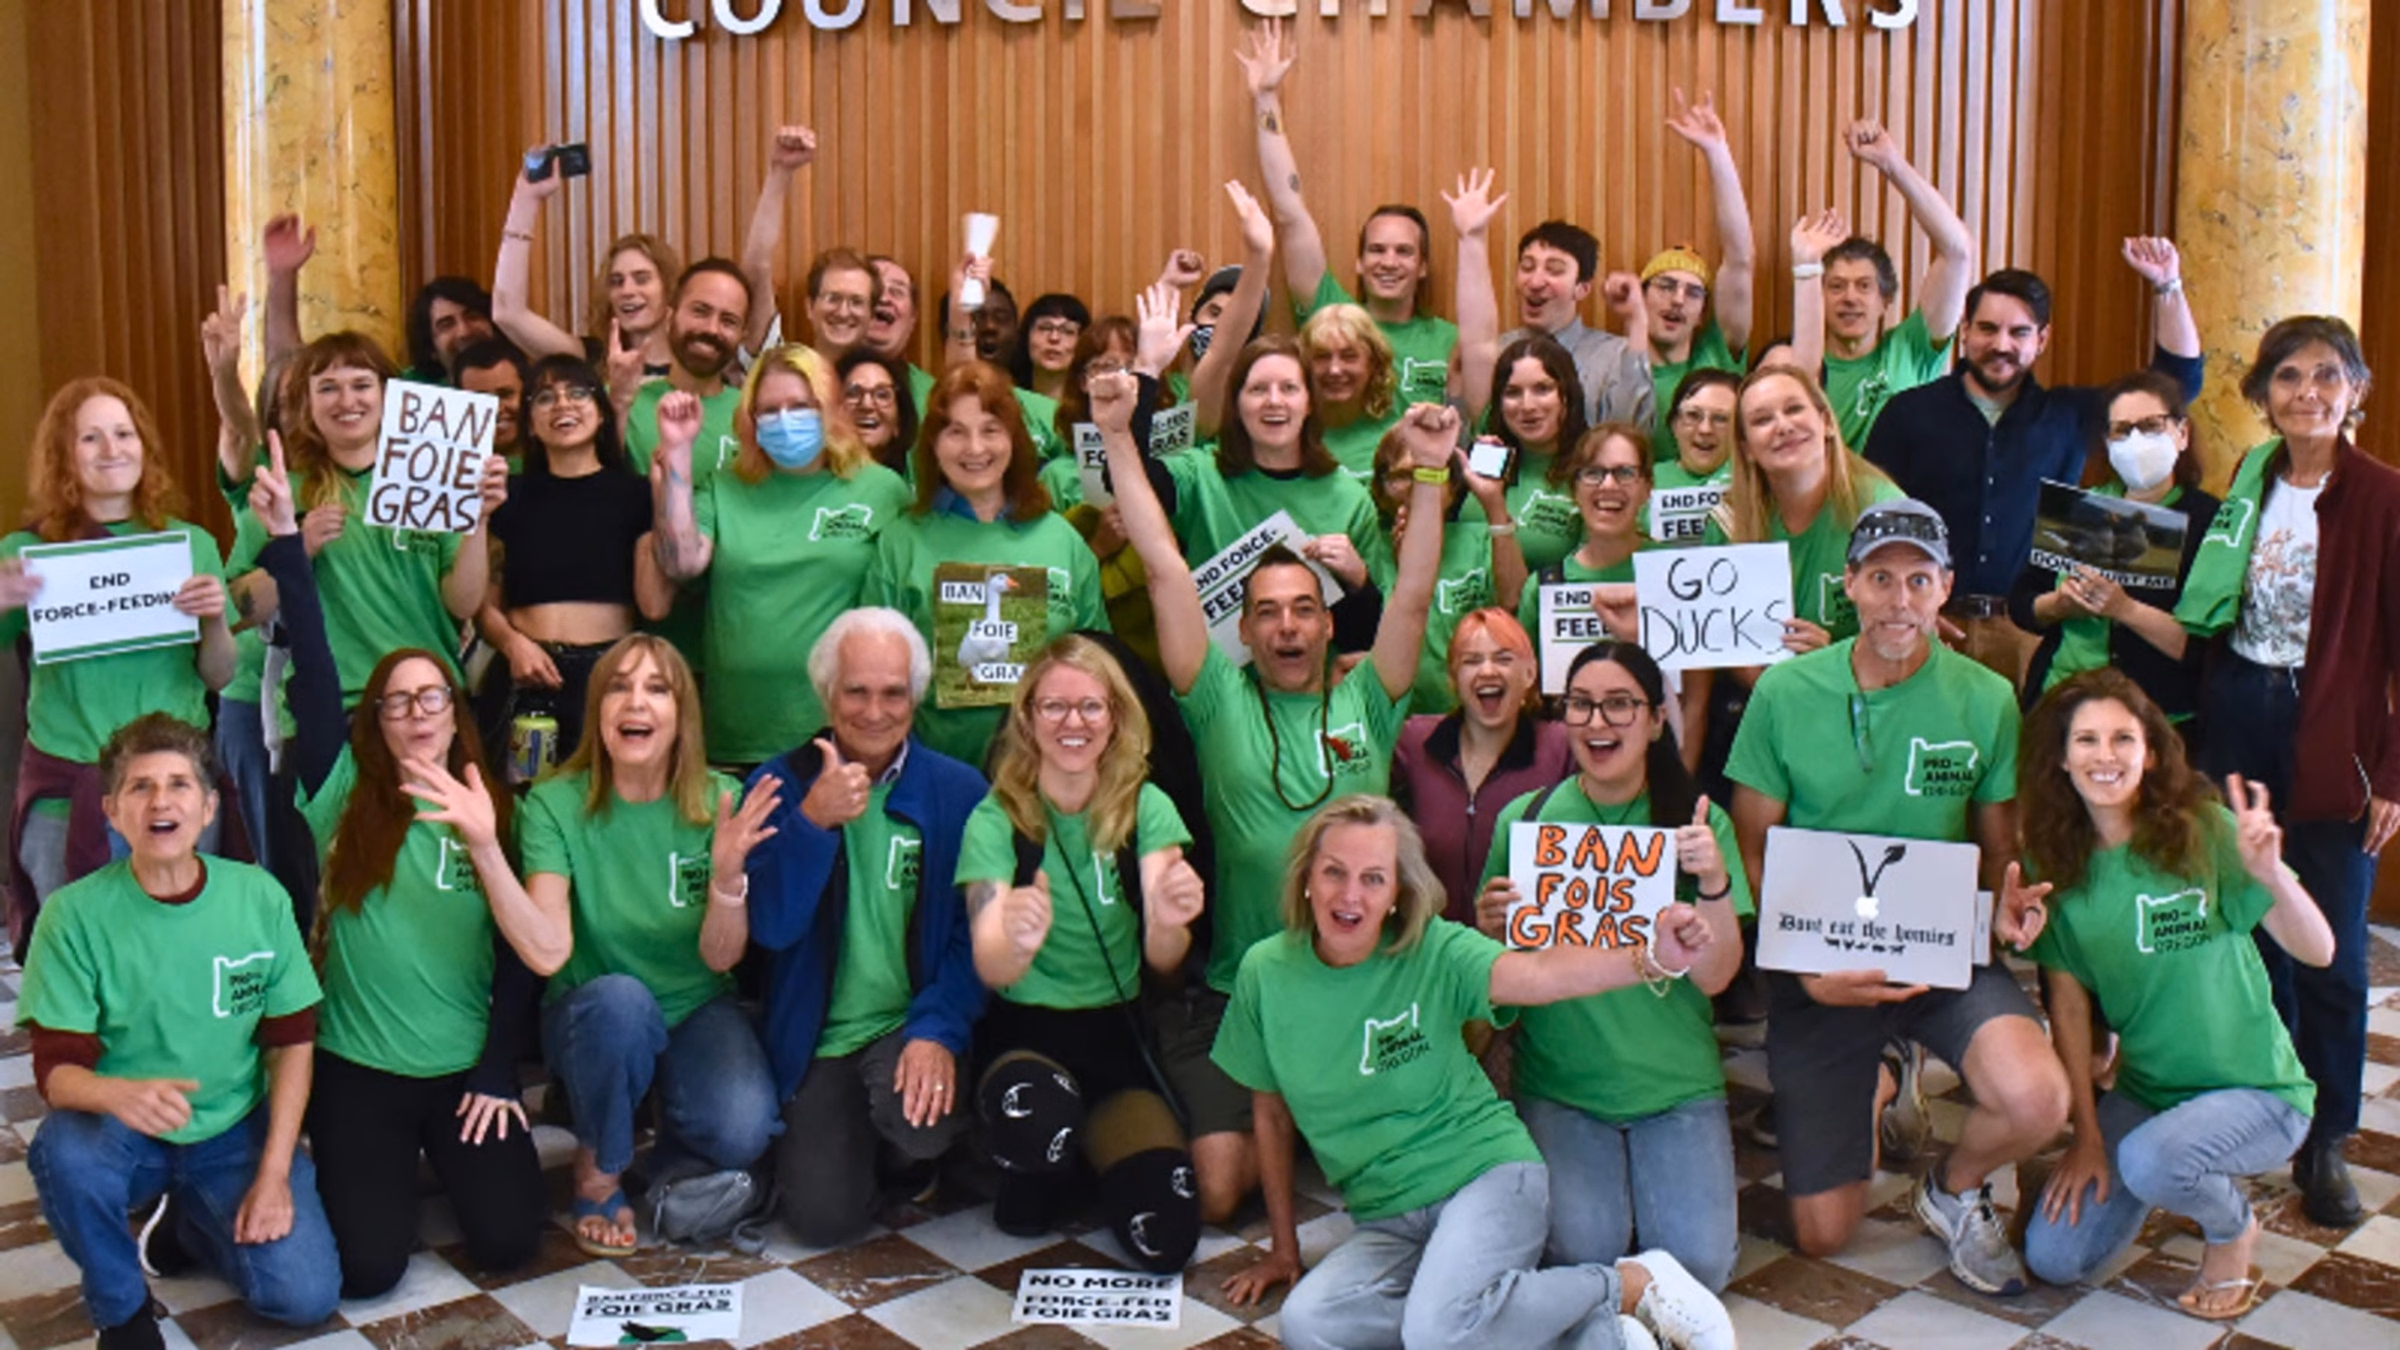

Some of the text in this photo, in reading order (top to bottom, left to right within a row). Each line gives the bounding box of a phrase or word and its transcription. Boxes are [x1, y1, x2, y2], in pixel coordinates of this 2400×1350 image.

[400, 391, 493, 448] BAN
[381, 437, 481, 490] FOIE
[372, 483, 479, 532] GRAS
[1662, 491, 1726, 508] END FO
[1220, 529, 1278, 571] FORCE-
[90, 573, 131, 589] END
[1667, 557, 1738, 601] GO
[944, 584, 983, 601] BAN
[1553, 591, 1592, 606] END
[973, 621, 1014, 638] FOIE
[1641, 599, 1789, 662] DUCKS
[1534, 825, 1666, 877] BAN
[1537, 873, 1635, 913] FOIS
[1510, 904, 1651, 949] GRAS
[1830, 921, 1855, 936] eat
[1862, 920, 1887, 940] the
[1896, 924, 1957, 947] homies
[1029, 1275, 1174, 1290] NO MORE
[585, 1299, 733, 1316] FOIE GRAS
[588, 1295, 626, 1305] BAN
[1026, 1296, 1172, 1308] FORCE-FED
[1023, 1306, 1171, 1322] FOIE GRAS
